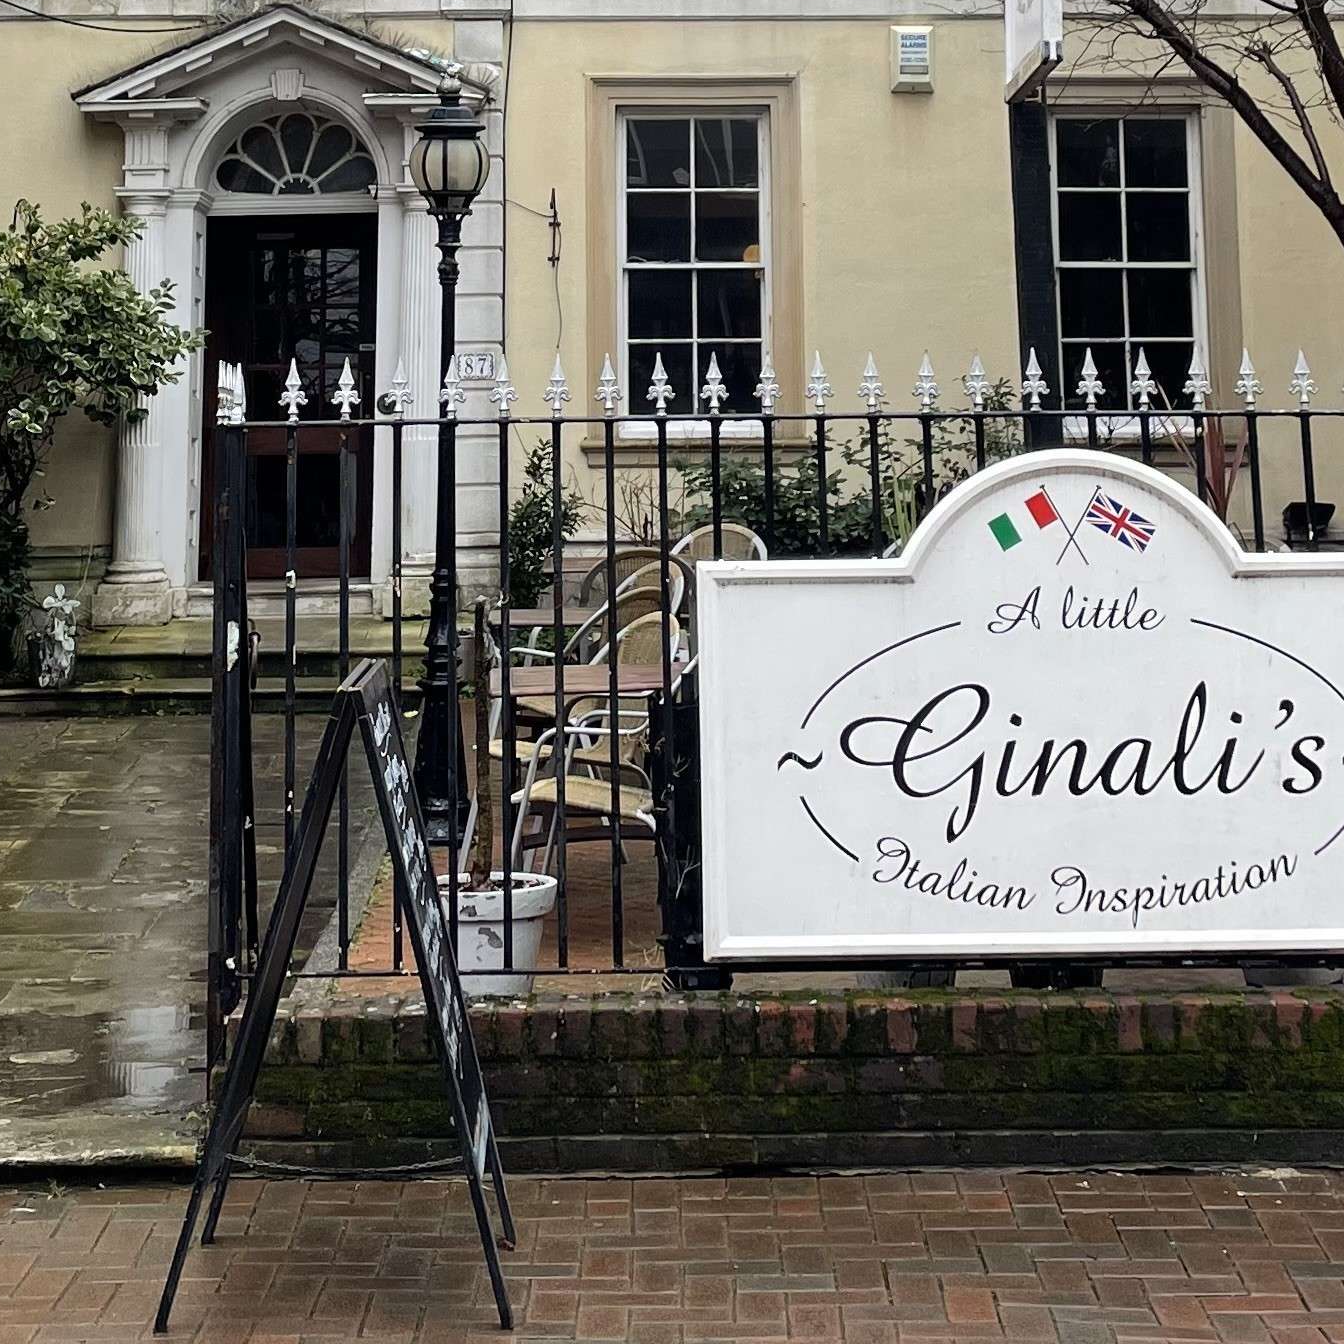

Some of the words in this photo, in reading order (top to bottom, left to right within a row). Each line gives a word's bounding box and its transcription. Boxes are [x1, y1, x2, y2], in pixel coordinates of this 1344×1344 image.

[464, 357, 487, 375] 87
[987, 585, 1042, 634] A
[1061, 586, 1167, 632] little
[839, 680, 1325, 844] Ginali's
[872, 836, 1035, 911] Italian
[1050, 854, 1298, 929] Inspiration
